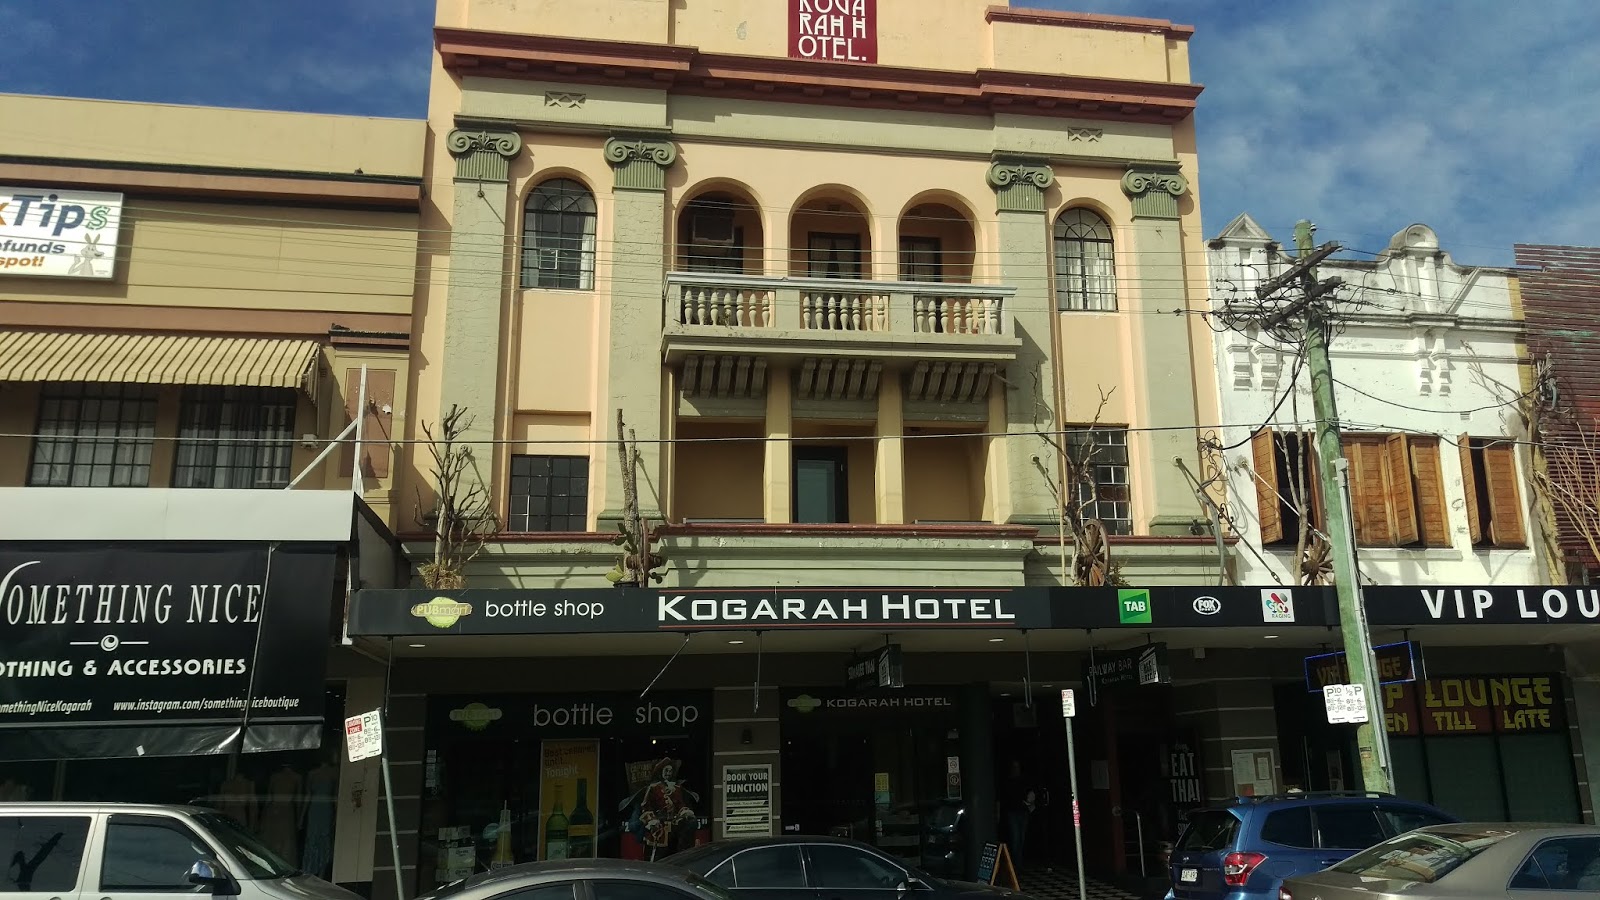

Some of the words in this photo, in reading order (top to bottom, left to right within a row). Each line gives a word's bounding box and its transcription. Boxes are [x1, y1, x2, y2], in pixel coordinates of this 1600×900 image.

[799, 13, 844, 36] RAH
[852, 17, 866, 39] H
[798, 36, 867, 61] OTEL.
[0, 240, 65, 254] funds
[187, 584, 262, 624] NICE
[485, 600, 547, 618] bottle
[554, 599, 604, 620] shop
[658, 595, 868, 621] KOGARAH
[882, 594, 1016, 620] HOTEL
[1124, 601, 1146, 612] TAB
[1198, 599, 1216, 609] FOX
[1421, 589, 1493, 619] VIP
[1517, 588, 1600, 619] LOU
[83, 660, 97, 676] &
[107, 659, 247, 676] ACCESSORIES
[1088, 661, 1116, 675] RAILWAY
[1118, 657, 1132, 671] BAR
[826, 698, 900, 708] KOGARAH
[904, 697, 952, 707] HOTEL
[1425, 678, 1553, 707] LOUNGE
[0, 699, 93, 715] methingNiceKogarah
[113, 696, 299, 714] www.instagram.com/somethingiceboutique
[533, 703, 613, 727] bottle
[635, 702, 699, 727] shop
[1385, 712, 1408, 732] EN
[1432, 711, 1476, 731] TILL
[1504, 709, 1550, 730] LATE
[1171, 753, 1194, 776] EAT
[727, 773, 747, 781] BOOK
[748, 772, 768, 781] YOUR
[727, 783, 768, 793] FUNCTION
[1171, 779, 1200, 803] THAI
